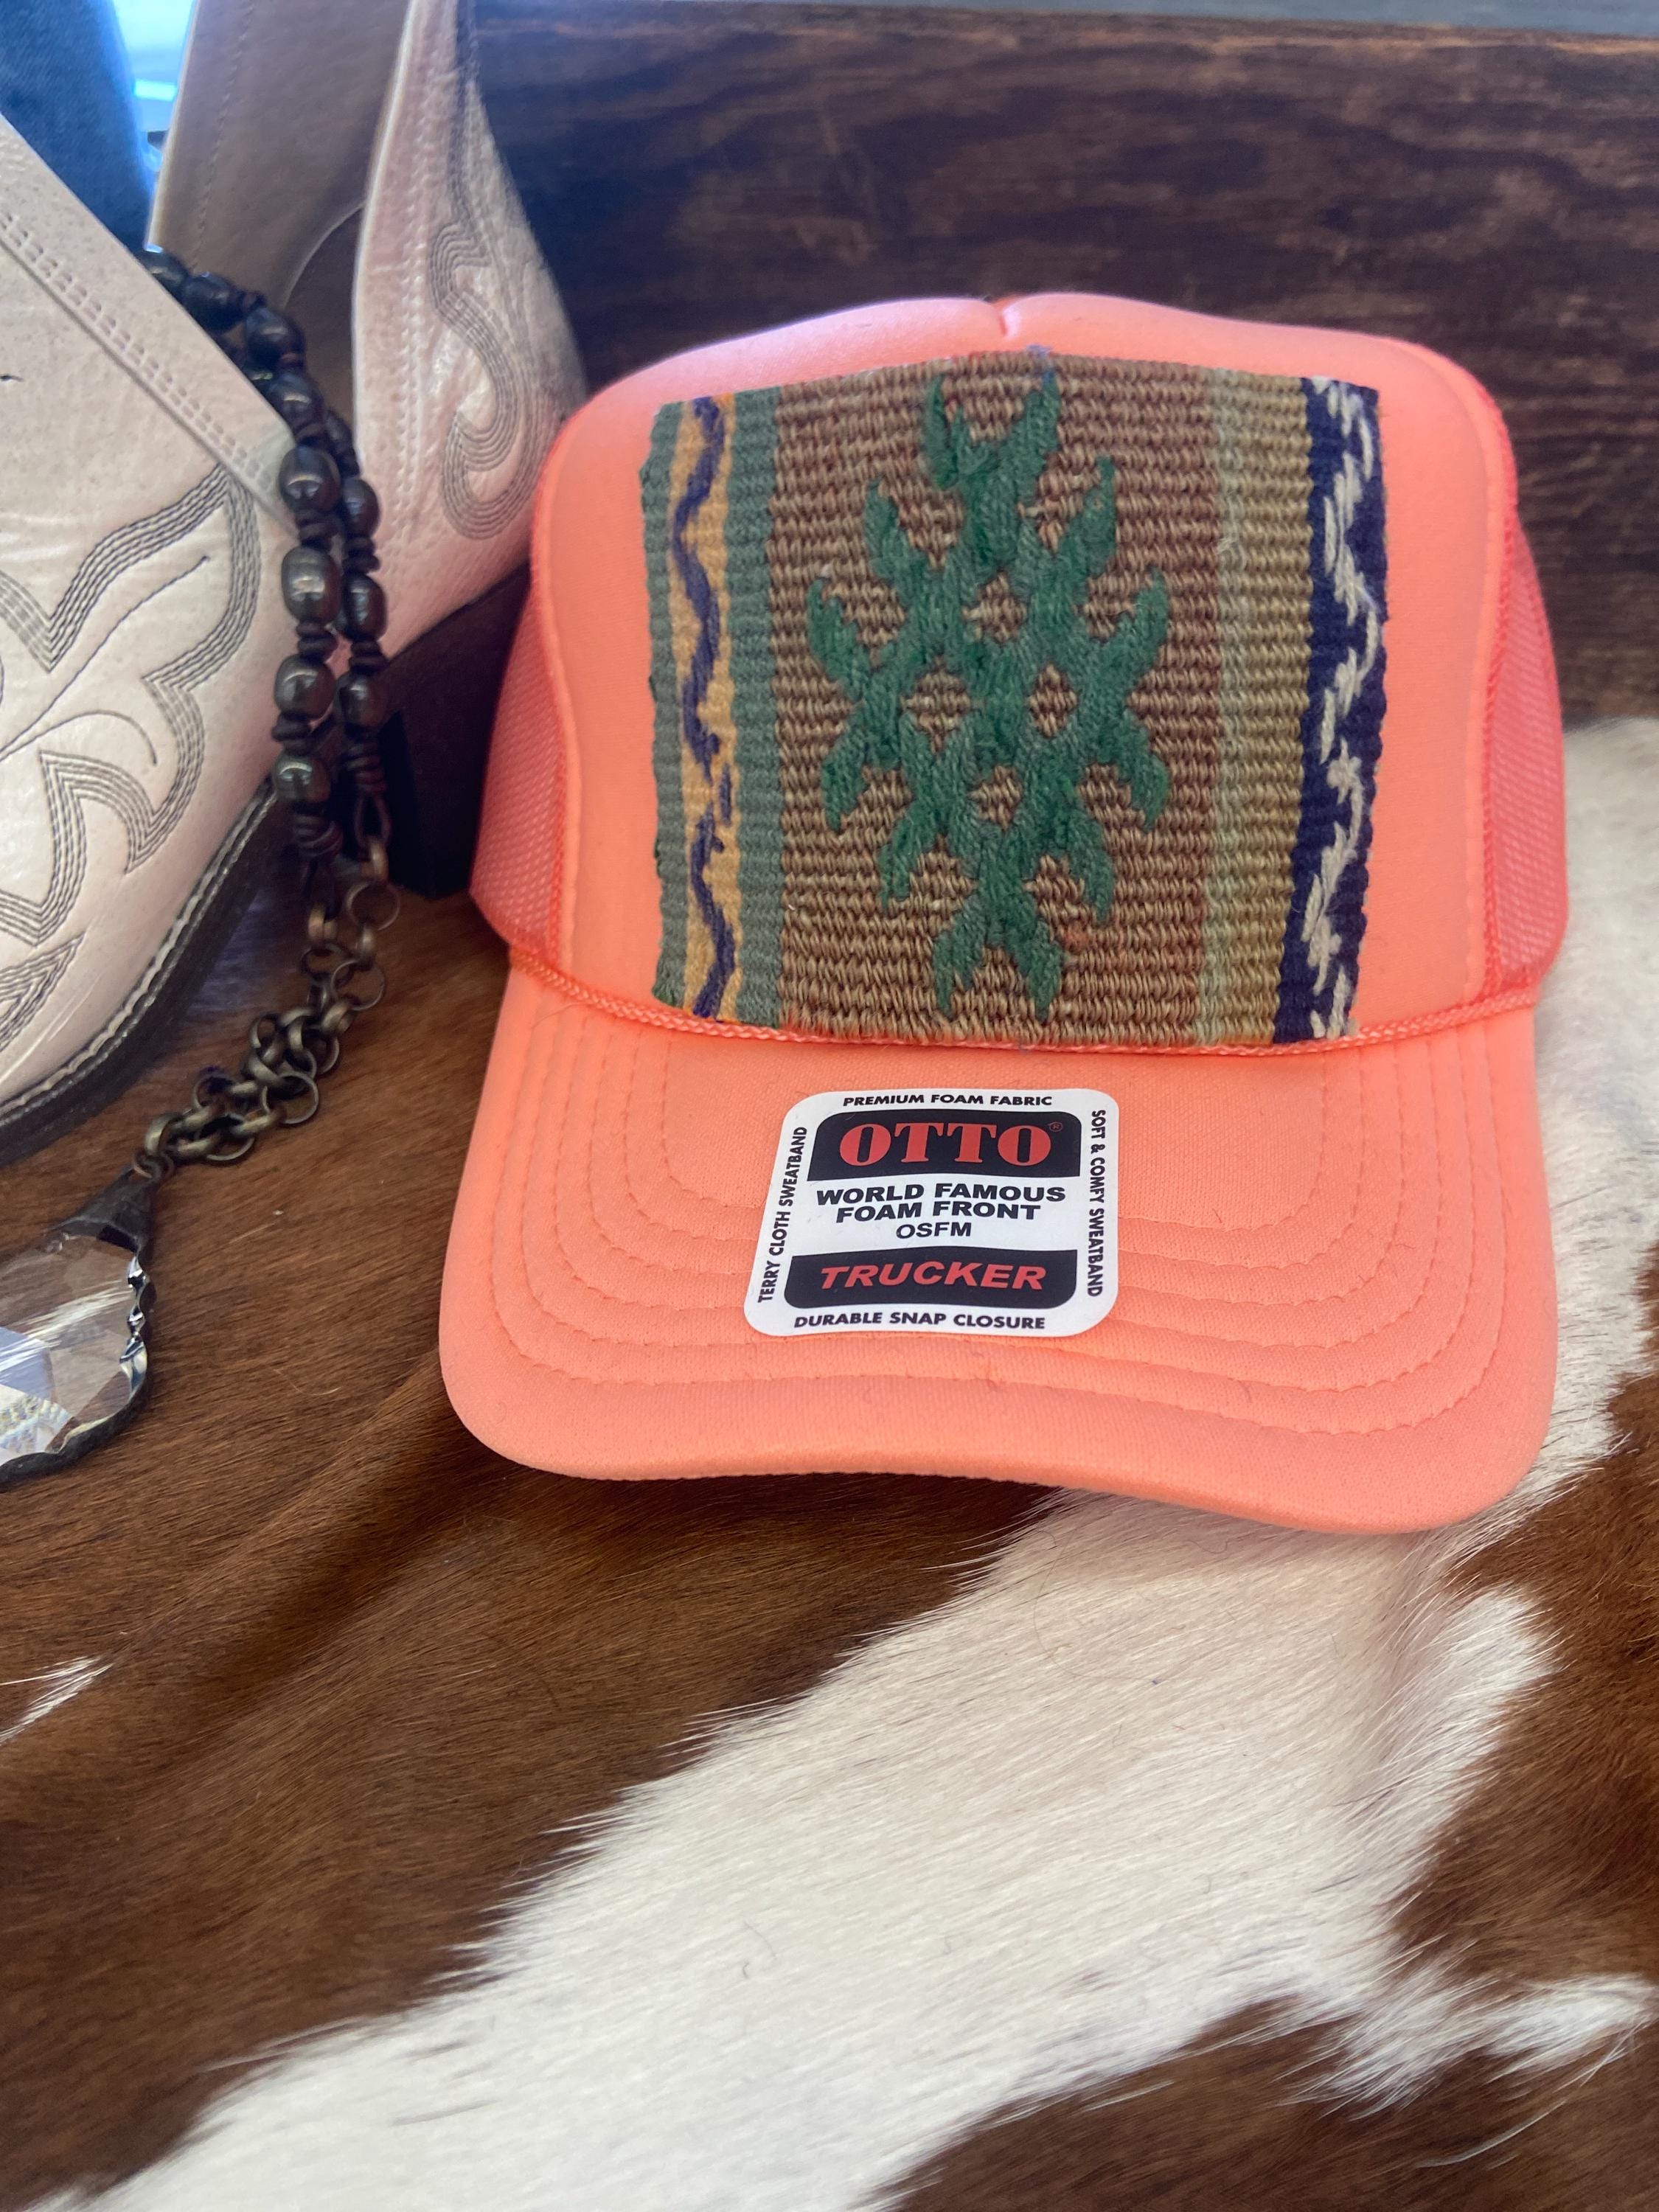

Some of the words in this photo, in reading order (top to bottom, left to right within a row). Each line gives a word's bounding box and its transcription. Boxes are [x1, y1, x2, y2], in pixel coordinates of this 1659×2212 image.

[844, 1095, 924, 1106] PREMIUM
[931, 1095, 984, 1105] FOAM
[990, 1096, 1052, 1105] FABRIC
[1091, 1110, 1106, 1139] SOFT
[1091, 1144, 1105, 1153] &
[779, 1127, 807, 1206] SWEATBAND
[1090, 1158, 1105, 1203] COMFY
[817, 1183, 924, 1205] WORLD
[935, 1183, 1065, 1201] FAMOUS
[836, 1203, 921, 1222] FOAM
[933, 1202, 1040, 1220] FRONT
[769, 1211, 790, 1255] CLOTH
[896, 1222, 971, 1239] OSFM
[1088, 1208, 1104, 1296] SWEATBAND
[758, 1261, 781, 1303] TERRY
[821, 1261, 1046, 1290] TRUCKER
[794, 1312, 881, 1328] DURABLE
[889, 1313, 946, 1324] SNAP
[953, 1314, 1045, 1329] CLOSURE
